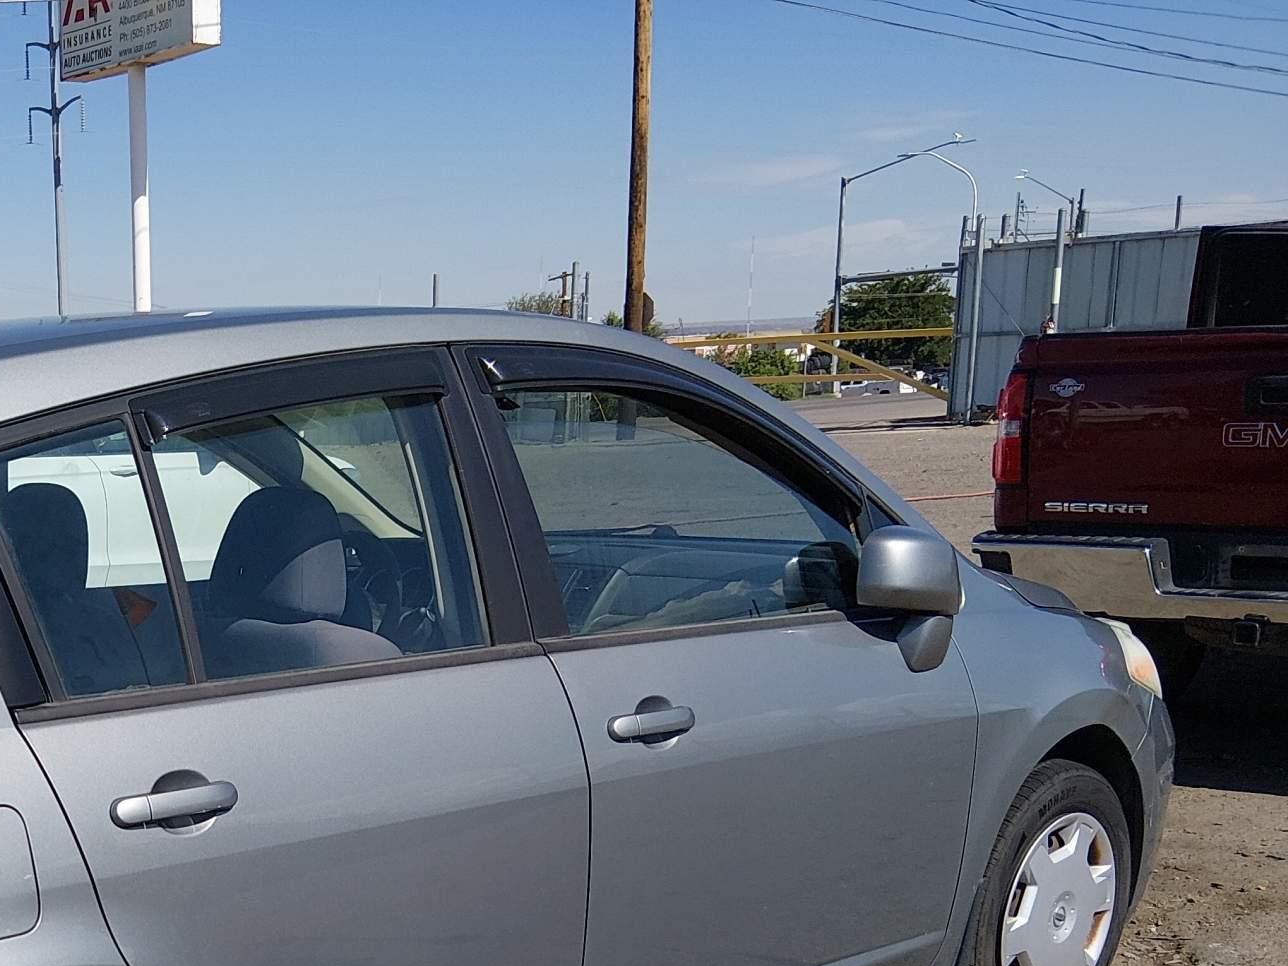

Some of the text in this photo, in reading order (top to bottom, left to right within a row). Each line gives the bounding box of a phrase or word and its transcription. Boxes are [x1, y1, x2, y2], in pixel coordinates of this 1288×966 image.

[156, 2, 167, 15] NM
[63, 25, 112, 49] INSURANCE
[130, 25, 146, 41] (505)
[63, 45, 112, 69] AUTO AUCTIONS
[1222, 422, 1288, 448] GM
[1044, 502, 1149, 514] SIERRA
